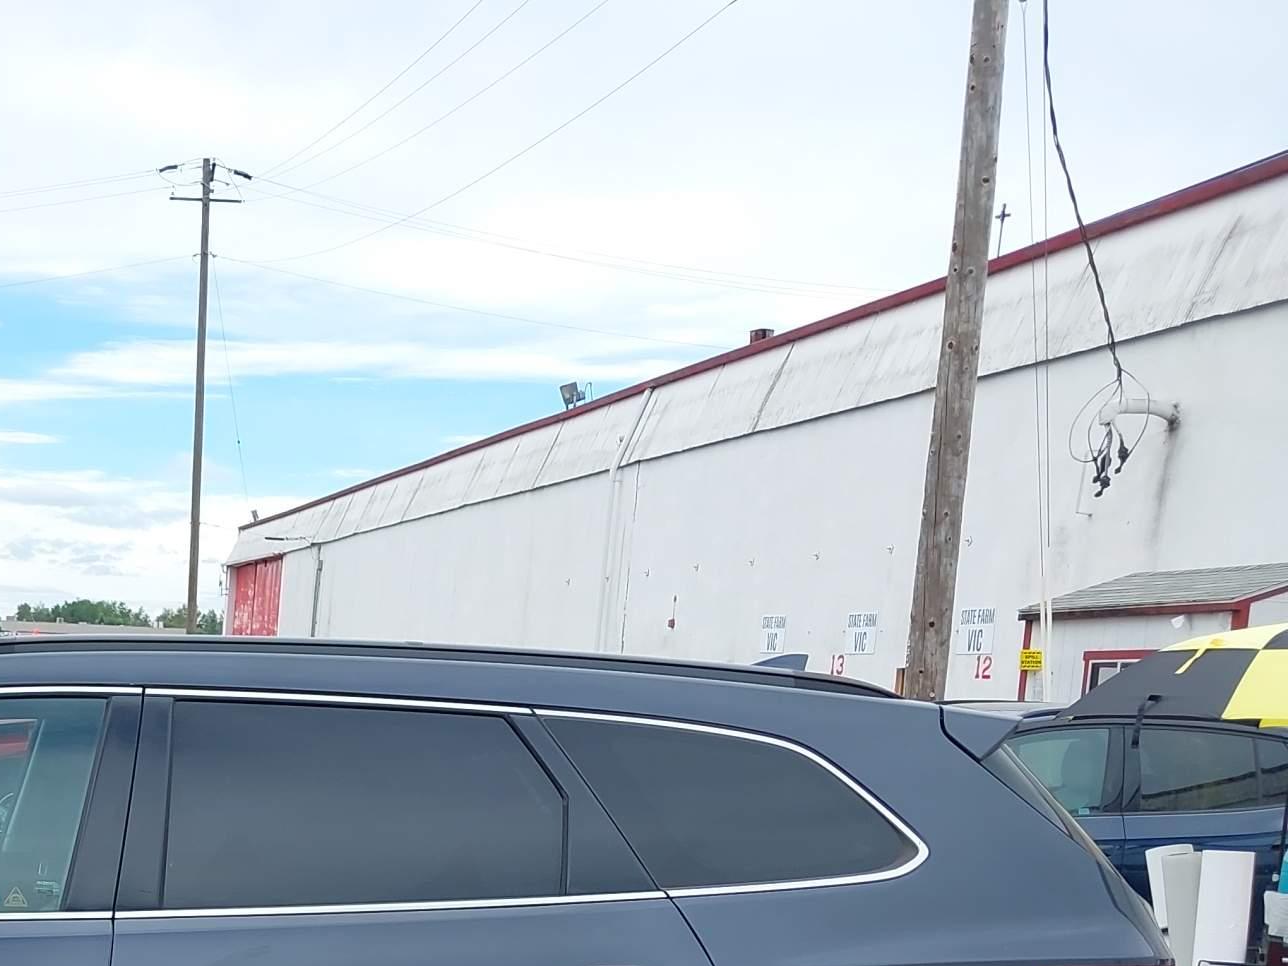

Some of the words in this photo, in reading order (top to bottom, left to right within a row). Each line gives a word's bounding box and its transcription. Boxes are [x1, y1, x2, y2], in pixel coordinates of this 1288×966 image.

[762, 616, 774, 629] STATE
[774, 616, 786, 629] FARM
[848, 614, 862, 628] STATE
[862, 613, 877, 627] FARM
[961, 609, 977, 625] STATE
[977, 608, 995, 624] FARM
[767, 632, 778, 652] VIC
[854, 631, 867, 652] VIC
[967, 629, 983, 652] VIC
[831, 654, 845, 676] 13
[975, 655, 992, 679] 12
